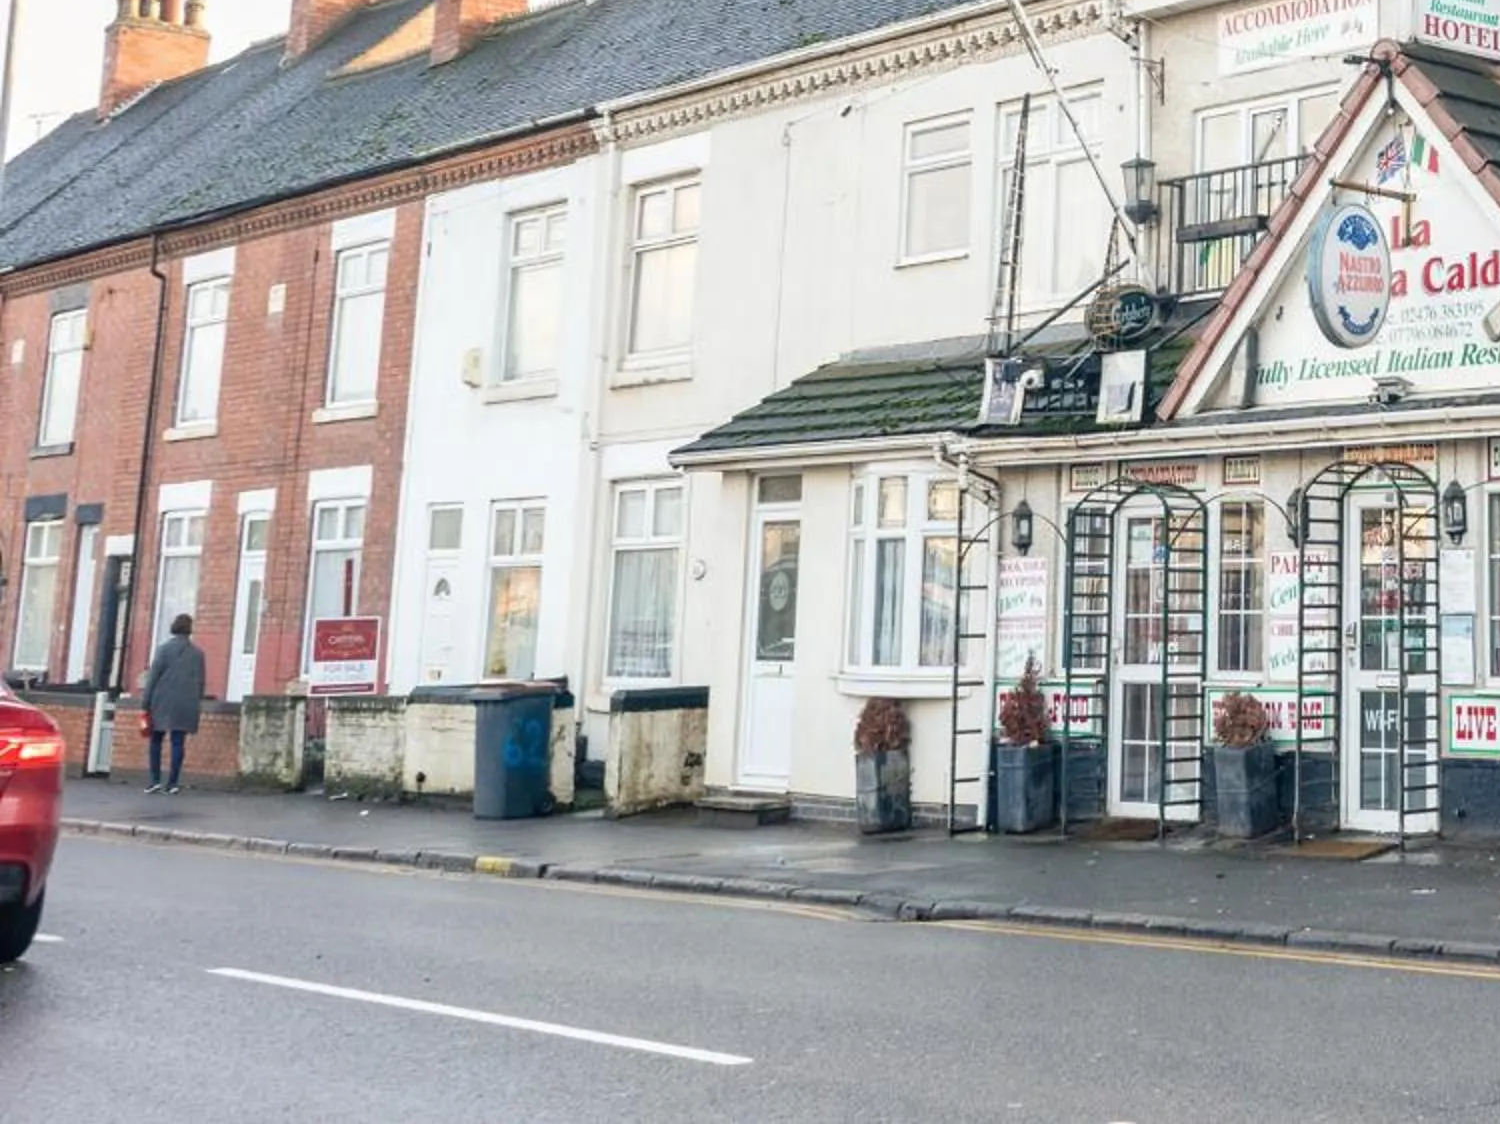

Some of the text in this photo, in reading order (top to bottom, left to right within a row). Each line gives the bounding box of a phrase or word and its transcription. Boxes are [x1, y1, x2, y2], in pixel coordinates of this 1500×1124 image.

[1391, 215, 1431, 251] La
[1255, 359, 1293, 390] ully
[1298, 350, 1381, 381] Licensed
[1386, 345, 1453, 373] Italian
[1456, 705, 1497, 741] LIVE
